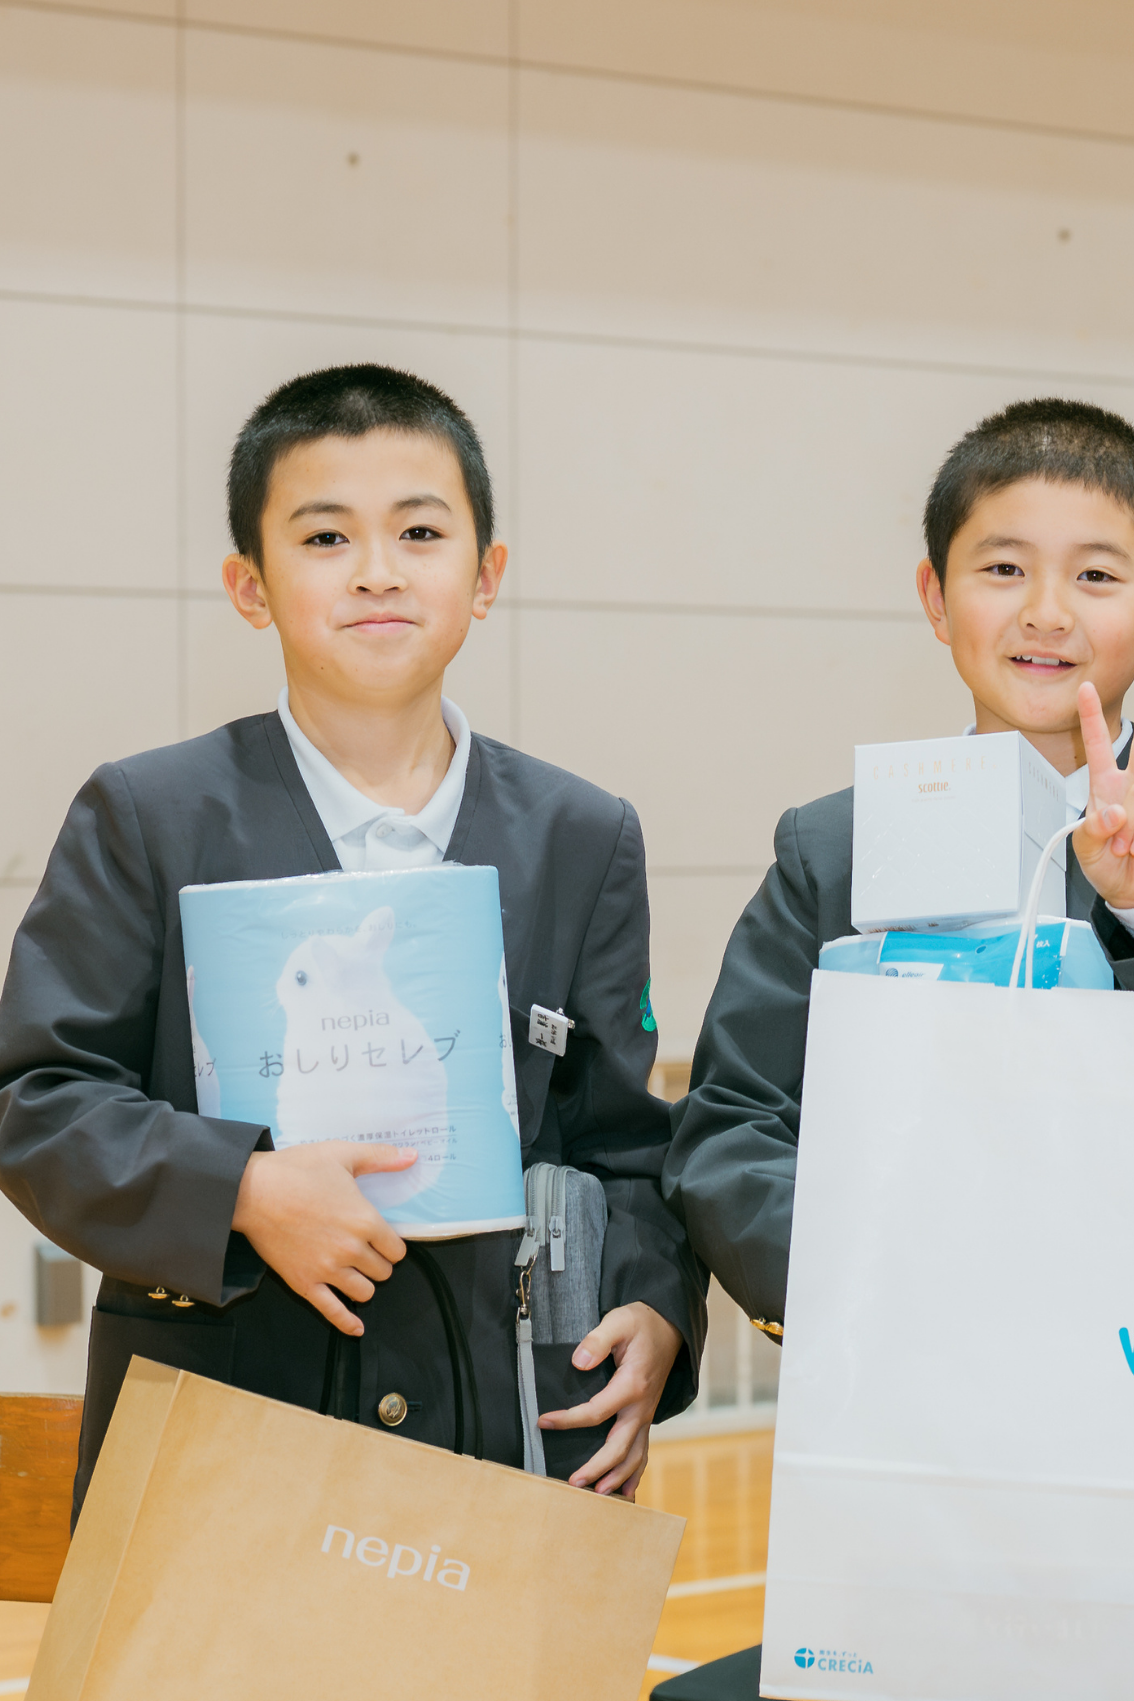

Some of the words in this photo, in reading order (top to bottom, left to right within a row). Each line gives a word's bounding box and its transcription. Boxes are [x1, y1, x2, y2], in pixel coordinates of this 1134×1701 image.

[321, 1009, 390, 1031] nepia
[257, 1029, 462, 1078] おしりセレブ
[320, 1524, 471, 1592] nepia
